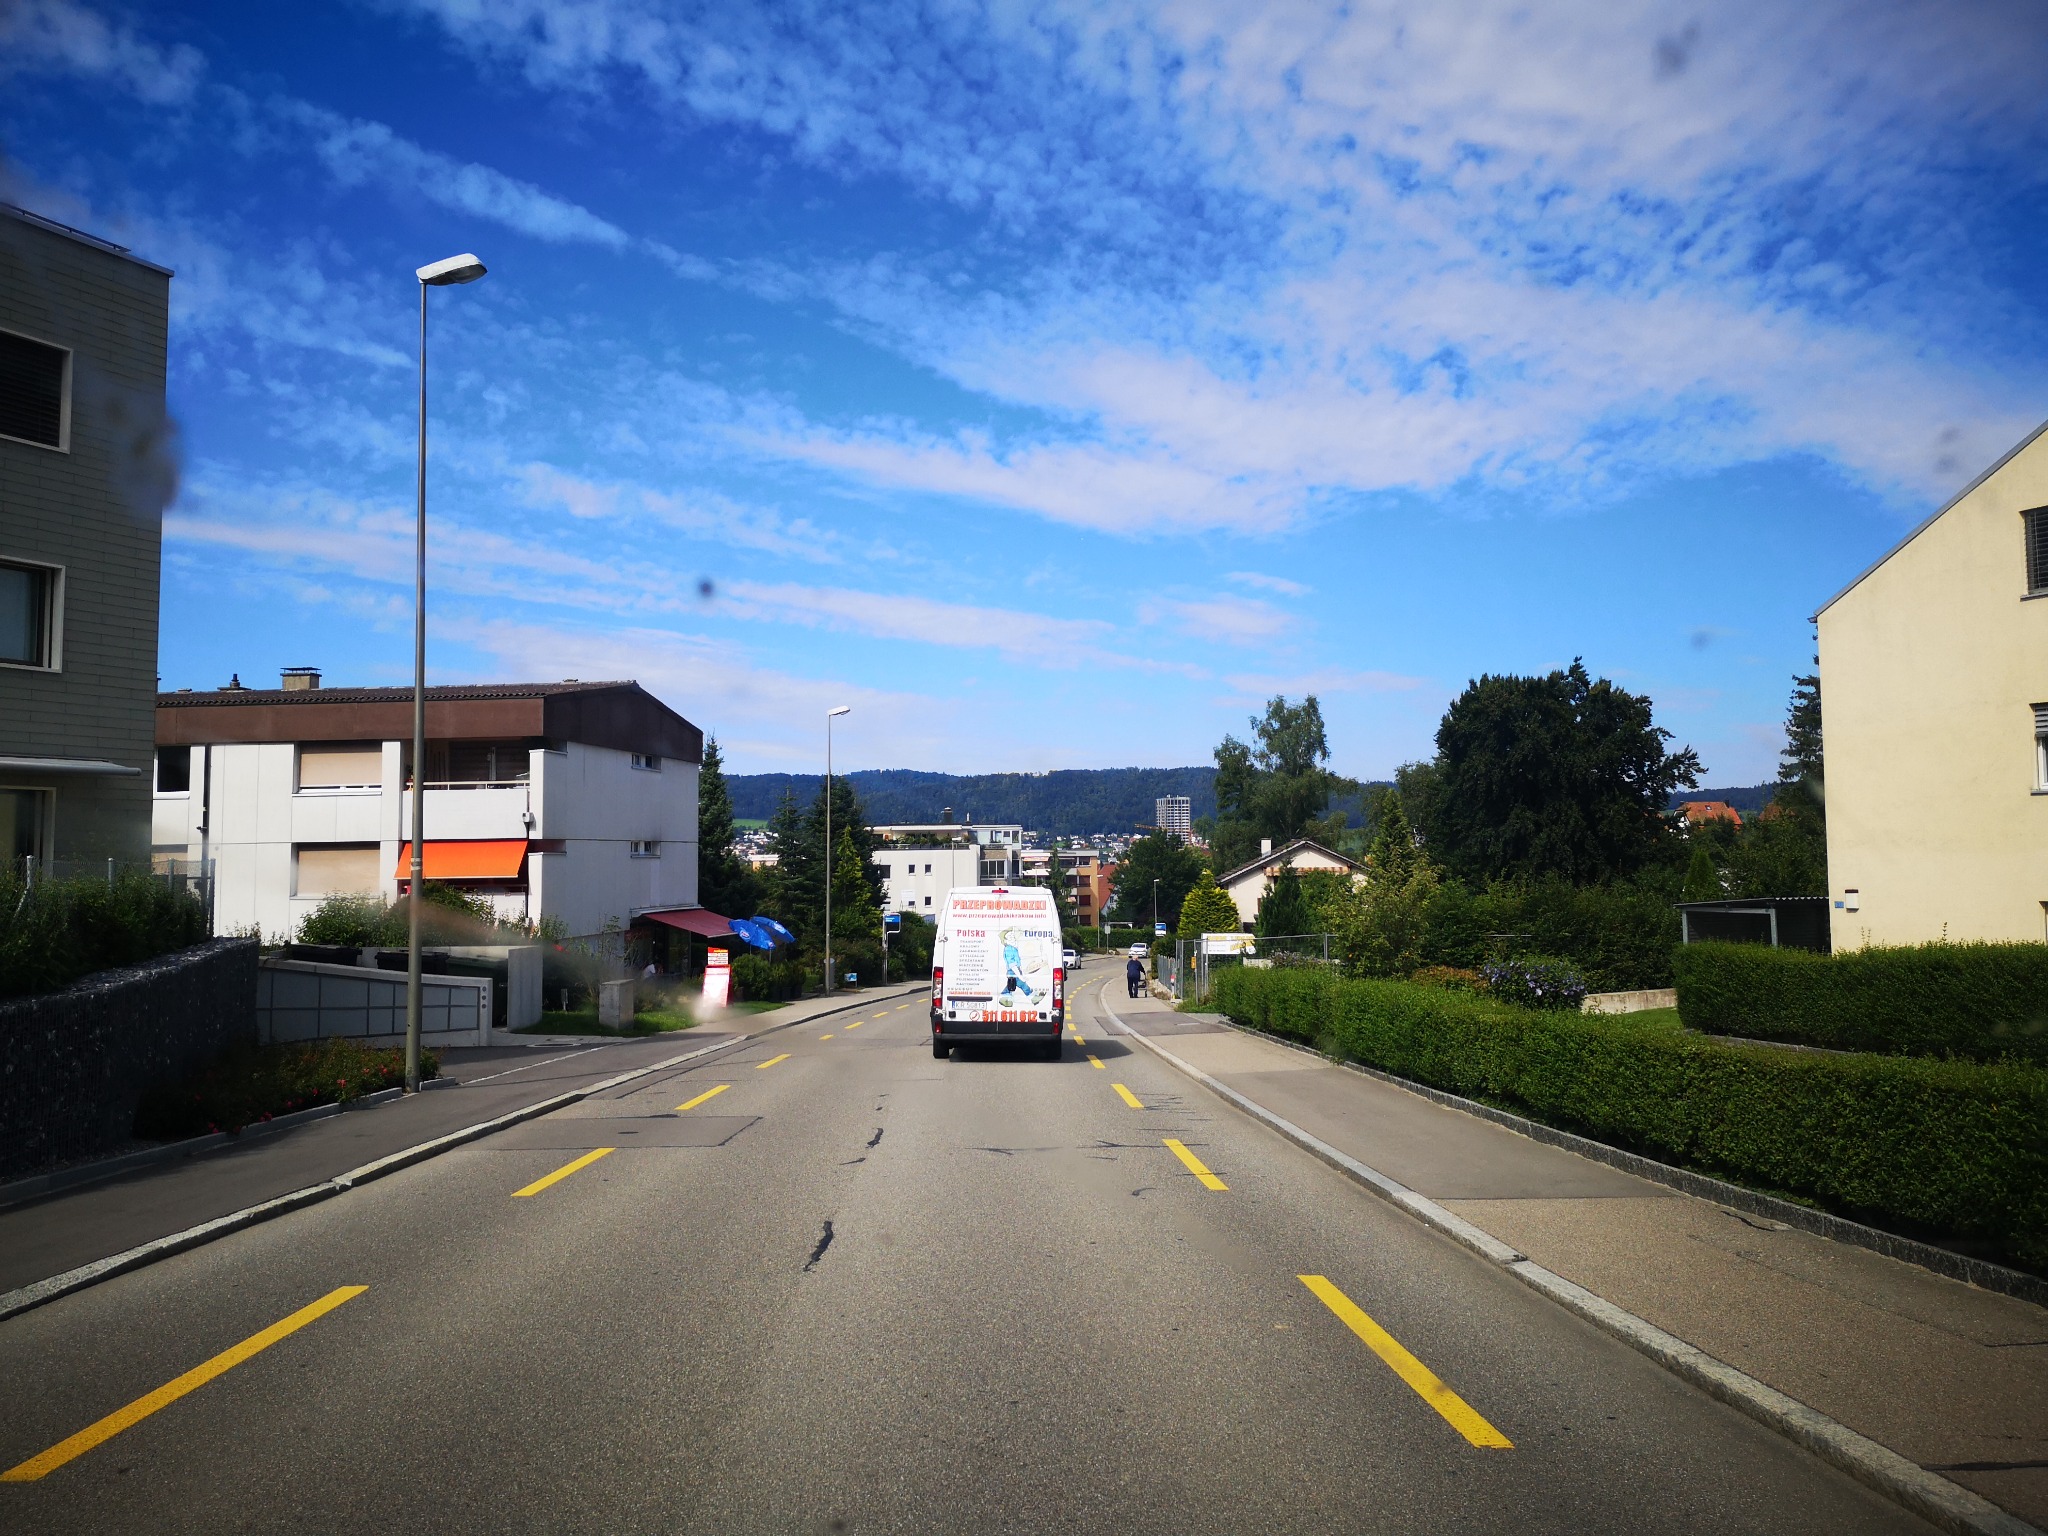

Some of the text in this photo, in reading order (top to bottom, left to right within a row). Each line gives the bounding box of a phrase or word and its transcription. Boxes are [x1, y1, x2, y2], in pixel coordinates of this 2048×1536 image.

[952, 900, 1046, 910] PRZEPROWADZKI
[957, 929, 985, 937] Polska
[1024, 929, 1053, 938] Europa
[982, 1010, 1038, 1022] 511 611 612
